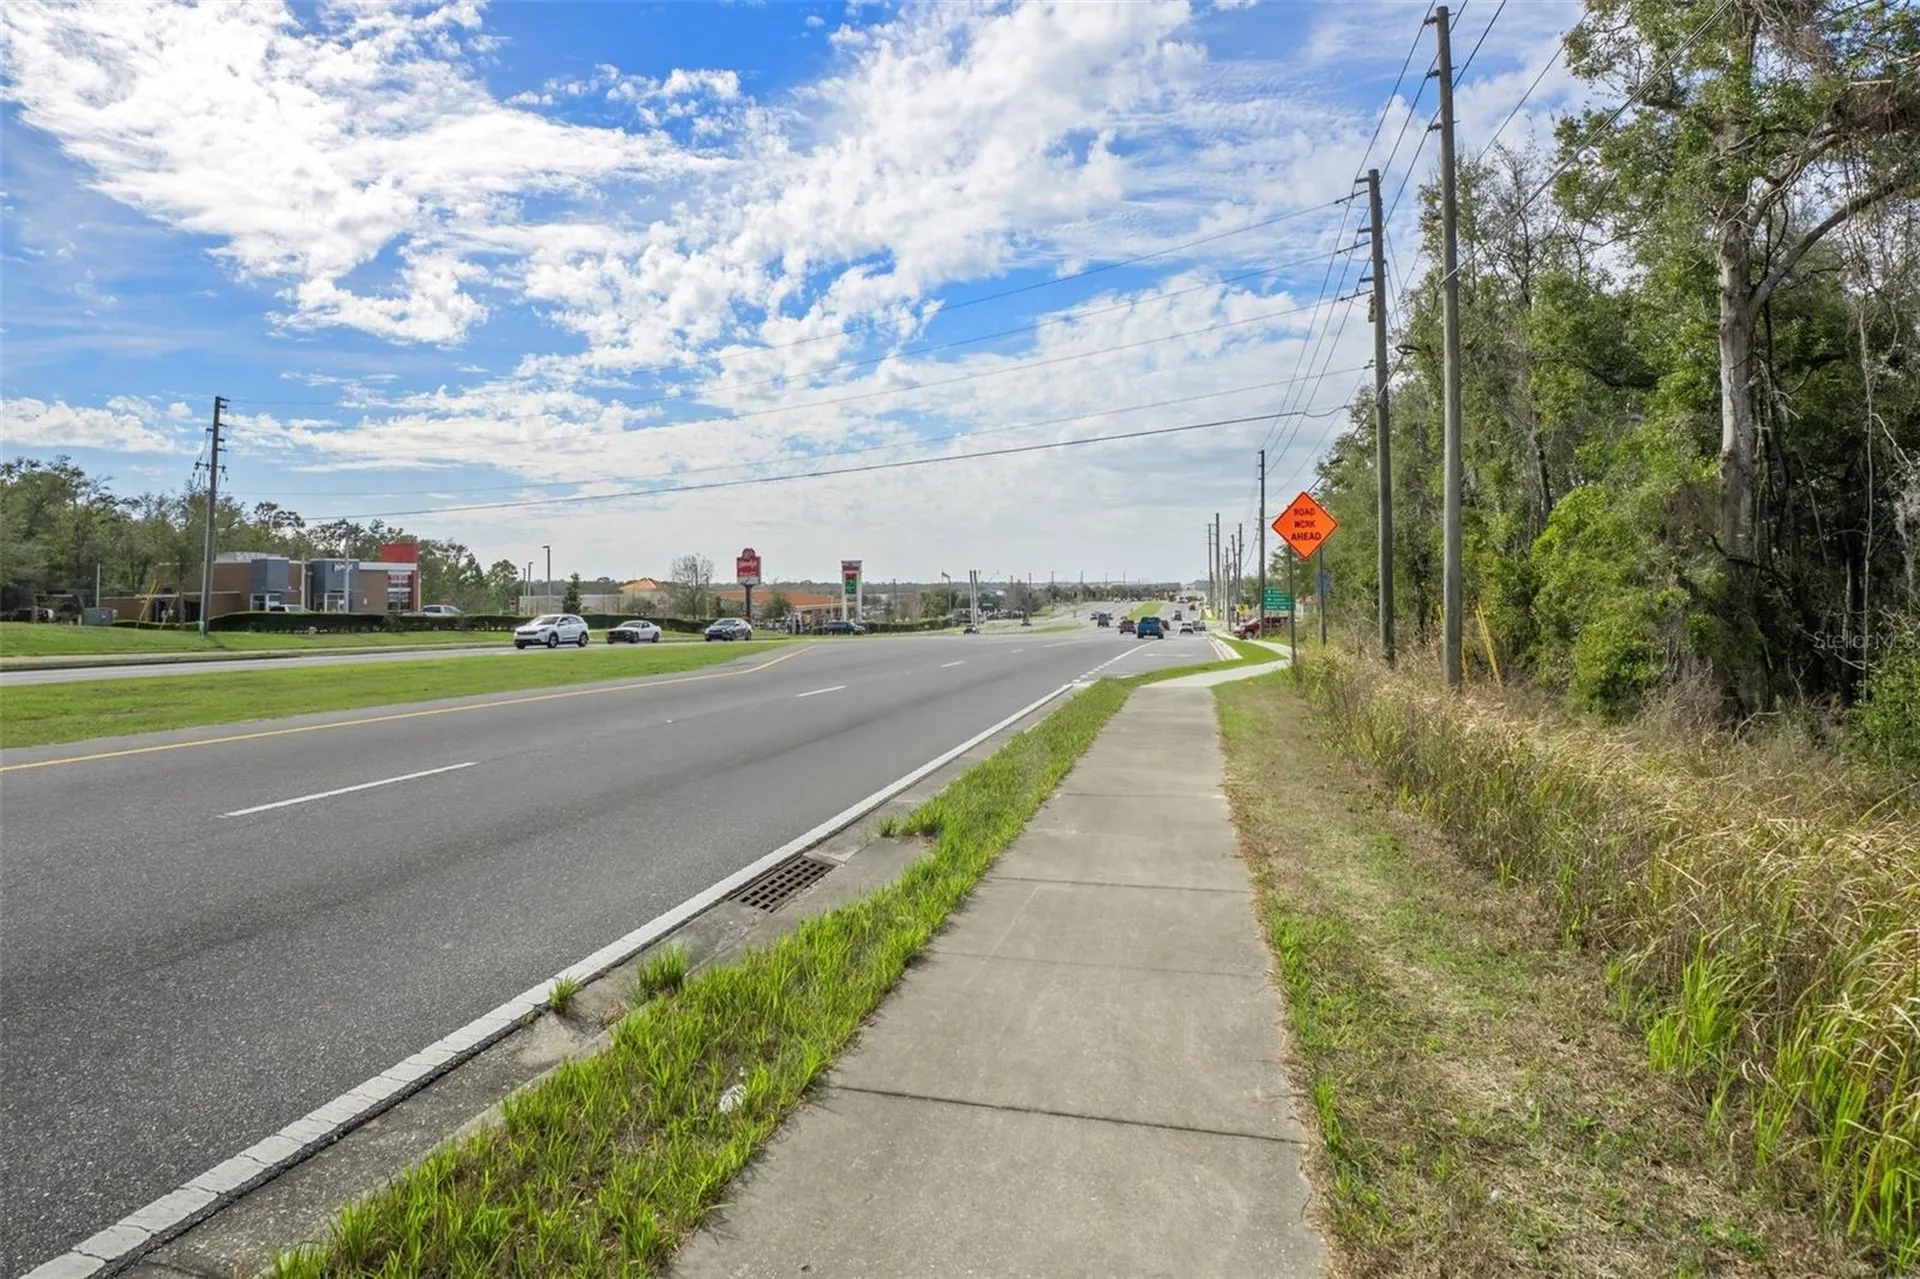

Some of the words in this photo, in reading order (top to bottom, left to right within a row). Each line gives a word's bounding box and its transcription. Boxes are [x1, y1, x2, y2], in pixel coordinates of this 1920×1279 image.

[1293, 508, 1315, 516] ROAD
[1294, 520, 1316, 528] WORK
[1291, 532, 1322, 541] AHEAD
